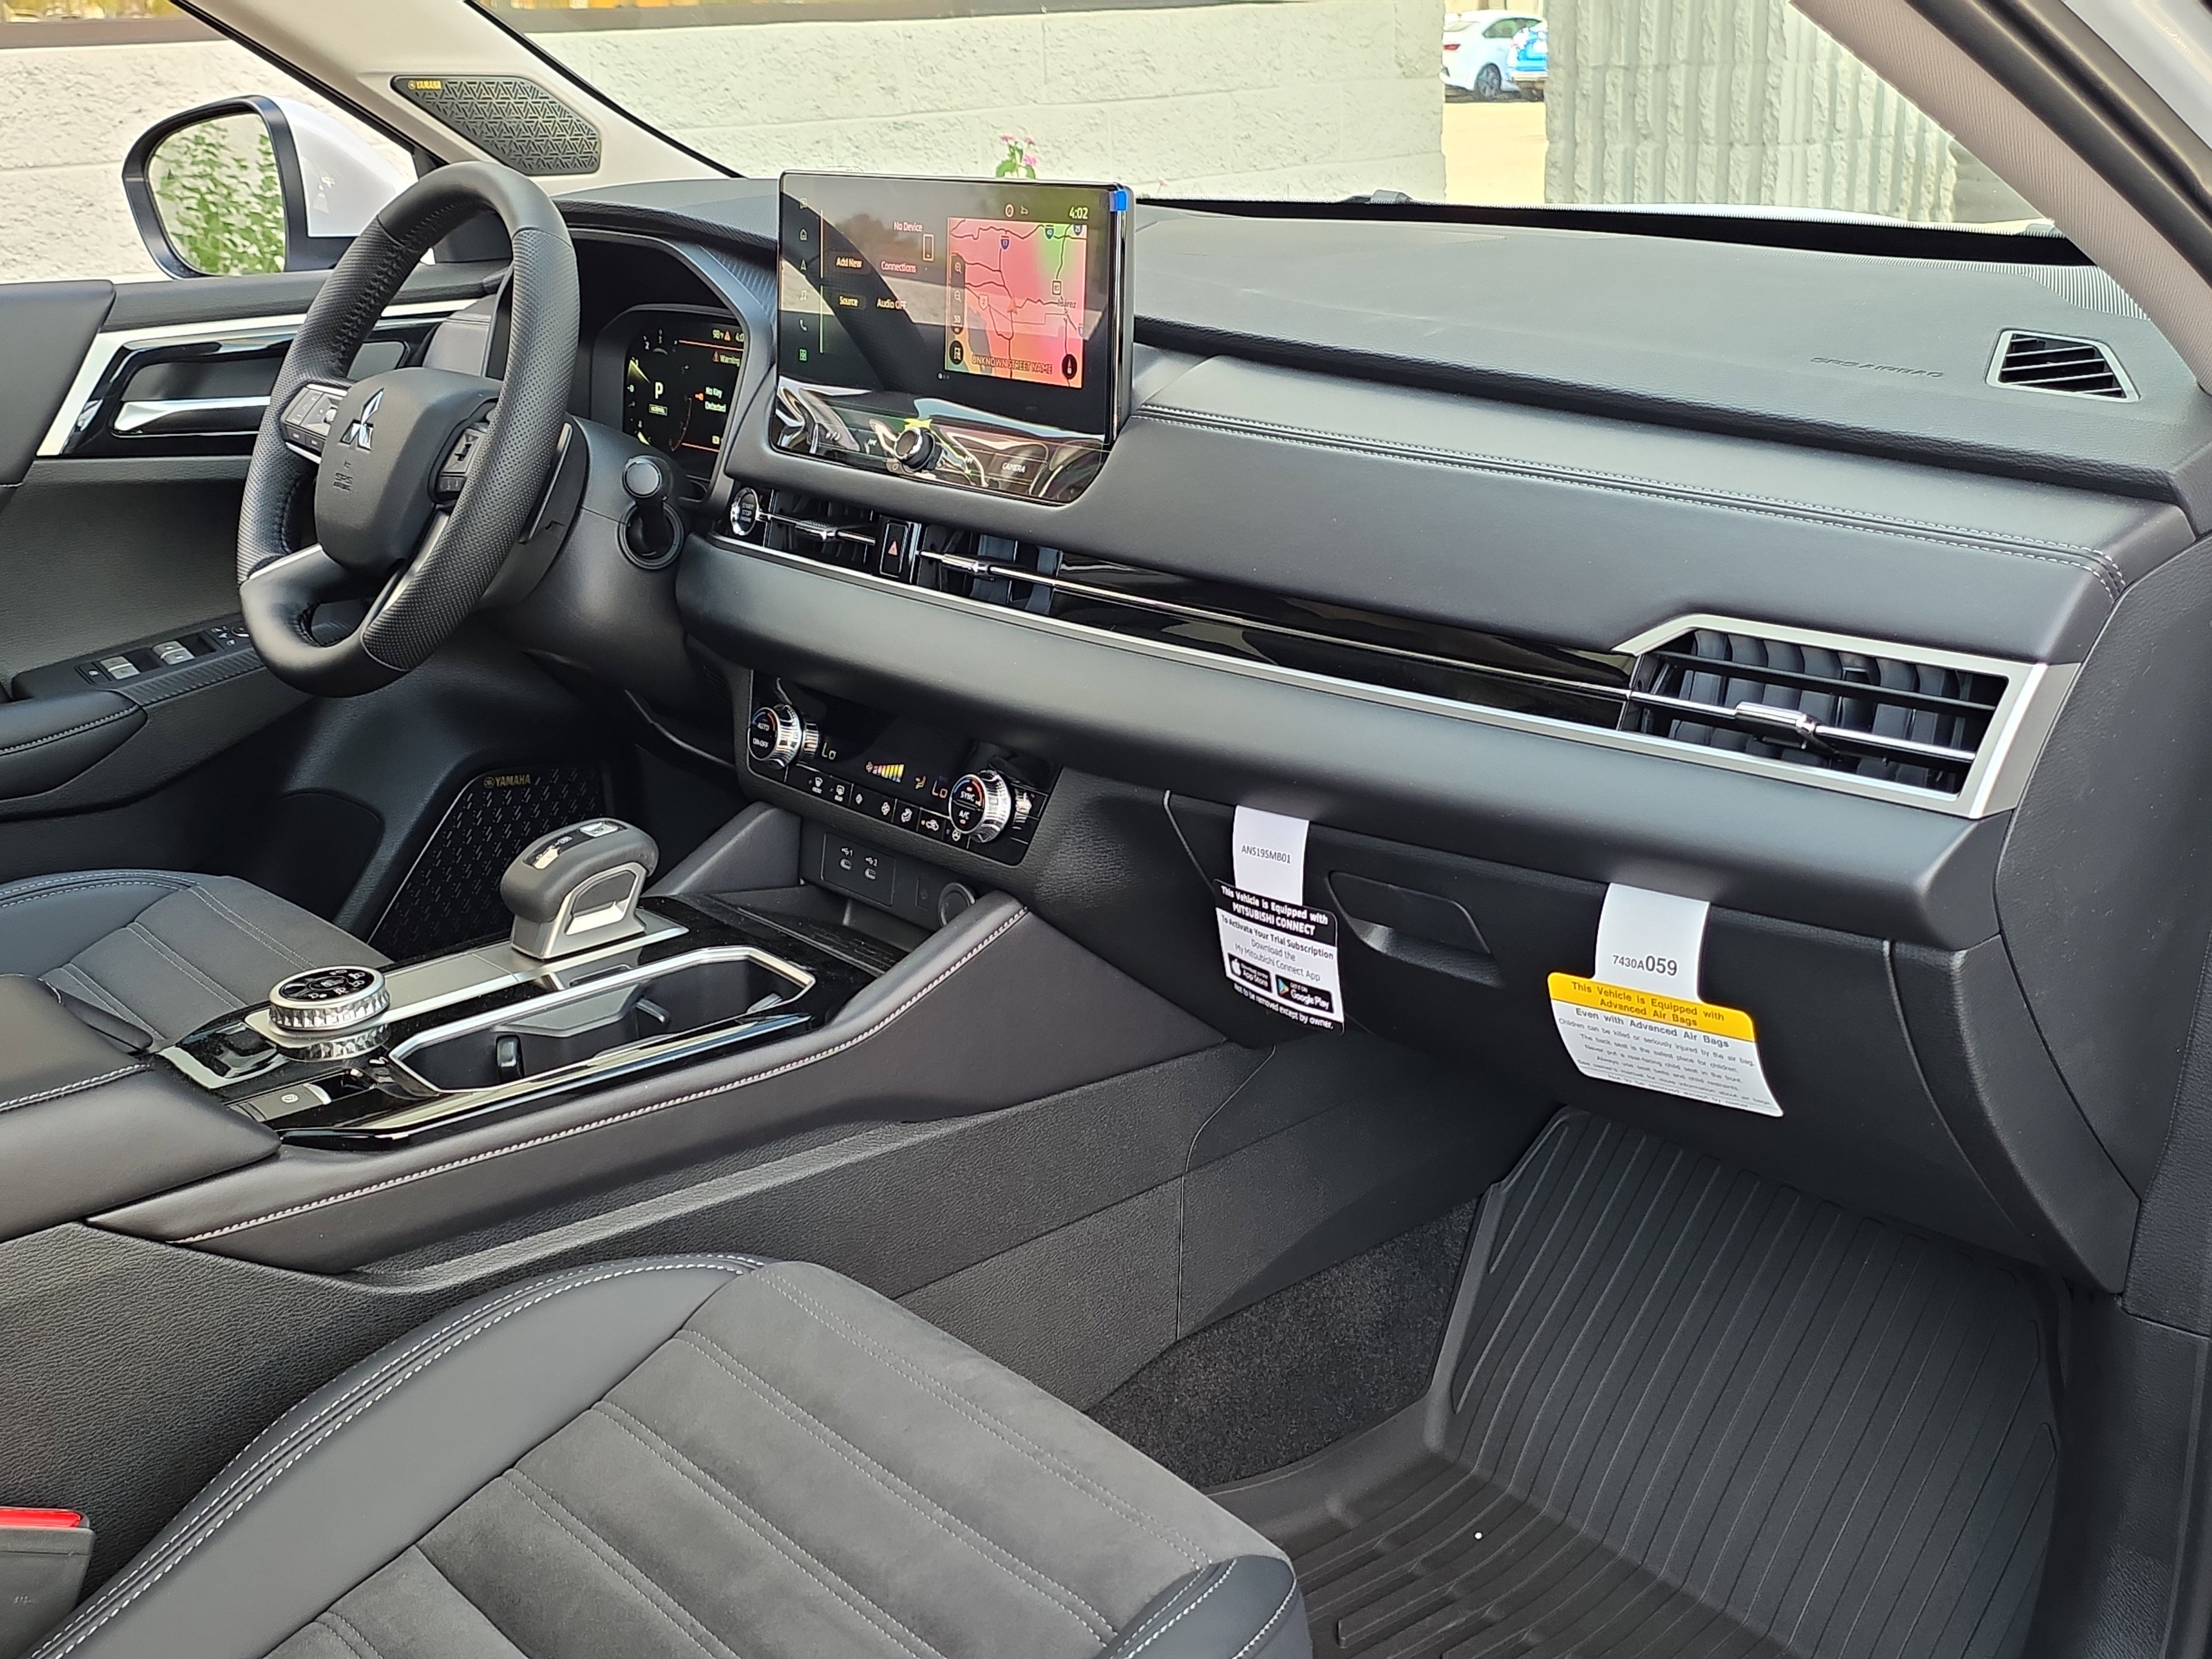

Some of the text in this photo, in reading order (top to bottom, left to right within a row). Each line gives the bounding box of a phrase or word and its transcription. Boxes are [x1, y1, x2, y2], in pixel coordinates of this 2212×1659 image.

[1069, 207, 1089, 219] 4:02
[893, 221, 923, 232] No Device
[836, 256, 862, 268] Add New
[881, 261, 916, 273] Connections
[839, 296, 858, 306] Source
[876, 298, 894, 308] Audio
[972, 355, 1053, 374] UNKNOWN STREET NAME
[654, 382, 664, 399] P
[1002, 462, 1026, 473] CAMERA
[821, 742, 837, 760] Lo
[495, 774, 531, 787] YAMAHA
[931, 780, 948, 799] Lo
[960, 790, 975, 802] SYNC
[958, 809, 970, 820] A/C
[1221, 885, 1328, 925] This Vehicle is Equipped with
[1232, 902, 1315, 936] MITSUBISHI CONNECT
[1221, 914, 1334, 960] To Activate Your Trial Subscription
[1251, 939, 1296, 962] Download the
[1276, 960, 1304, 976] Connect
[1306, 970, 1321, 982] App
[1612, 955, 1677, 976] 7430A059
[1290, 989, 1329, 1010] Google Play
[1572, 981, 1592, 993] This
[1597, 987, 1632, 1001] Vehicle
[1651, 998, 1697, 1015] Equipped
[1702, 1010, 1724, 1021] with
[1299, 1013, 1308, 1024] by
[1600, 999, 1697, 1026] Advanced Air Bags
[1576, 1008, 1729, 1048] Even with Advanced Air Bags
